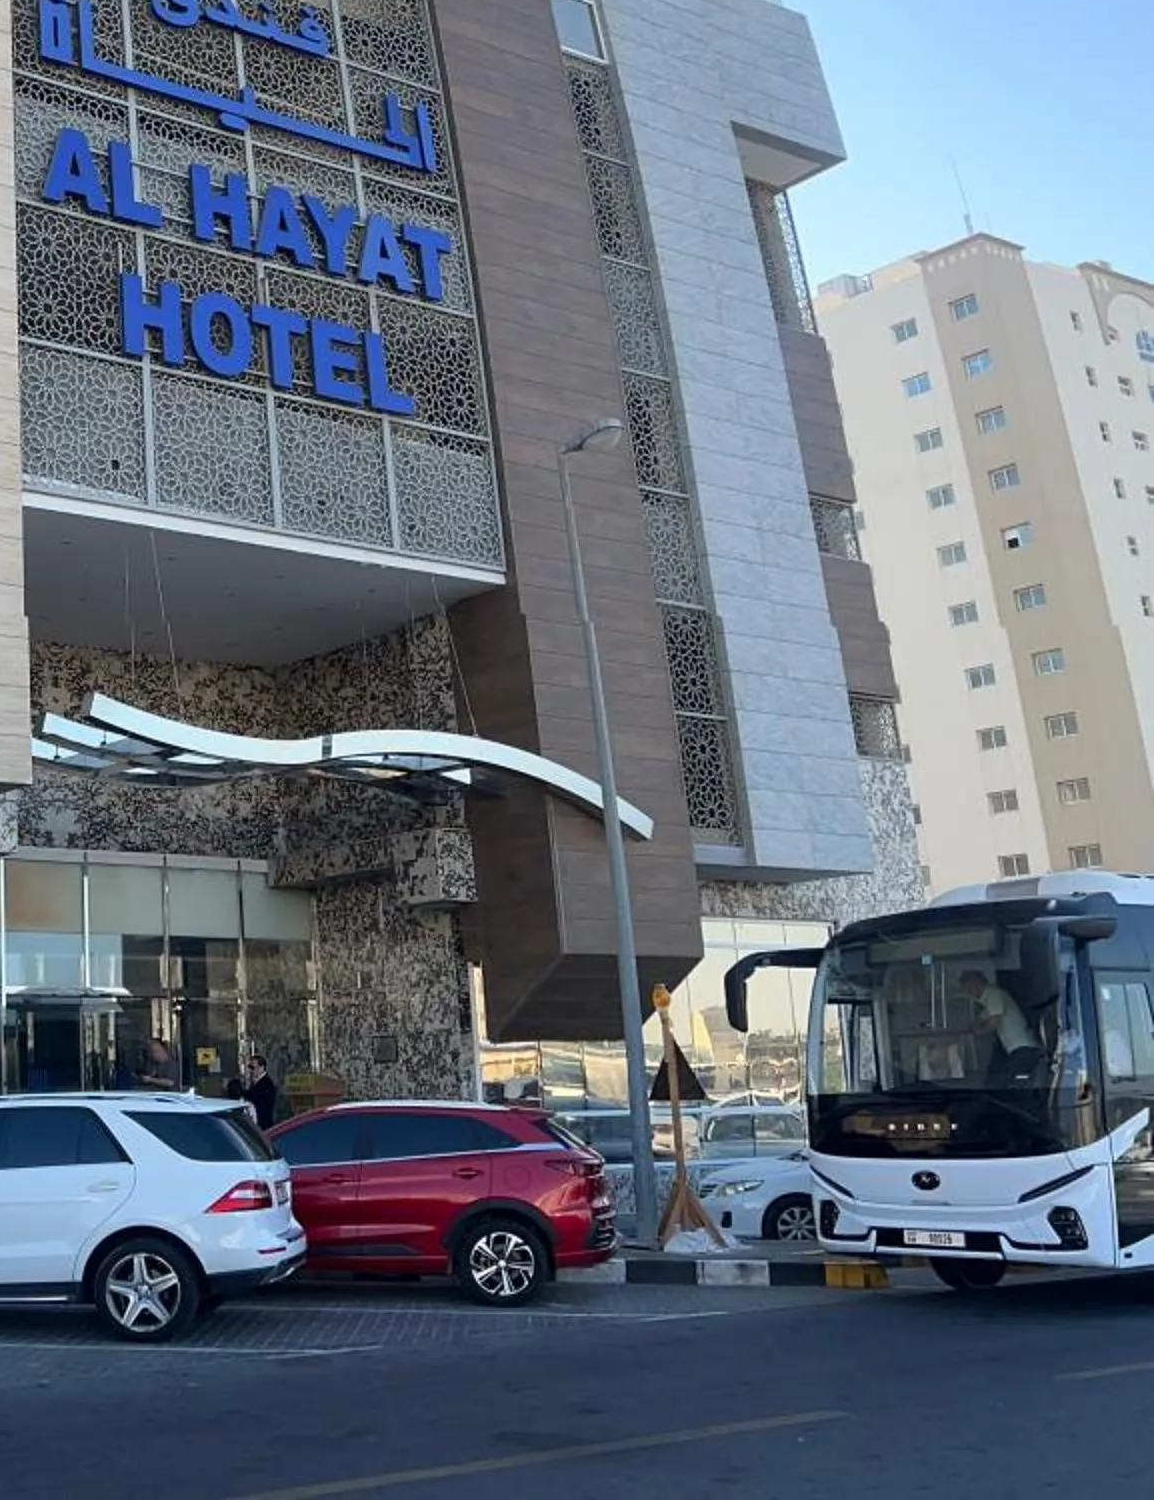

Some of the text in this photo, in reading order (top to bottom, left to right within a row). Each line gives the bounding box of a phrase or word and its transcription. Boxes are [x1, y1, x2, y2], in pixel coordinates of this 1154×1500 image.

[45, 127, 453, 301] AL HAYAT
[119, 270, 416, 416] HOTEL
